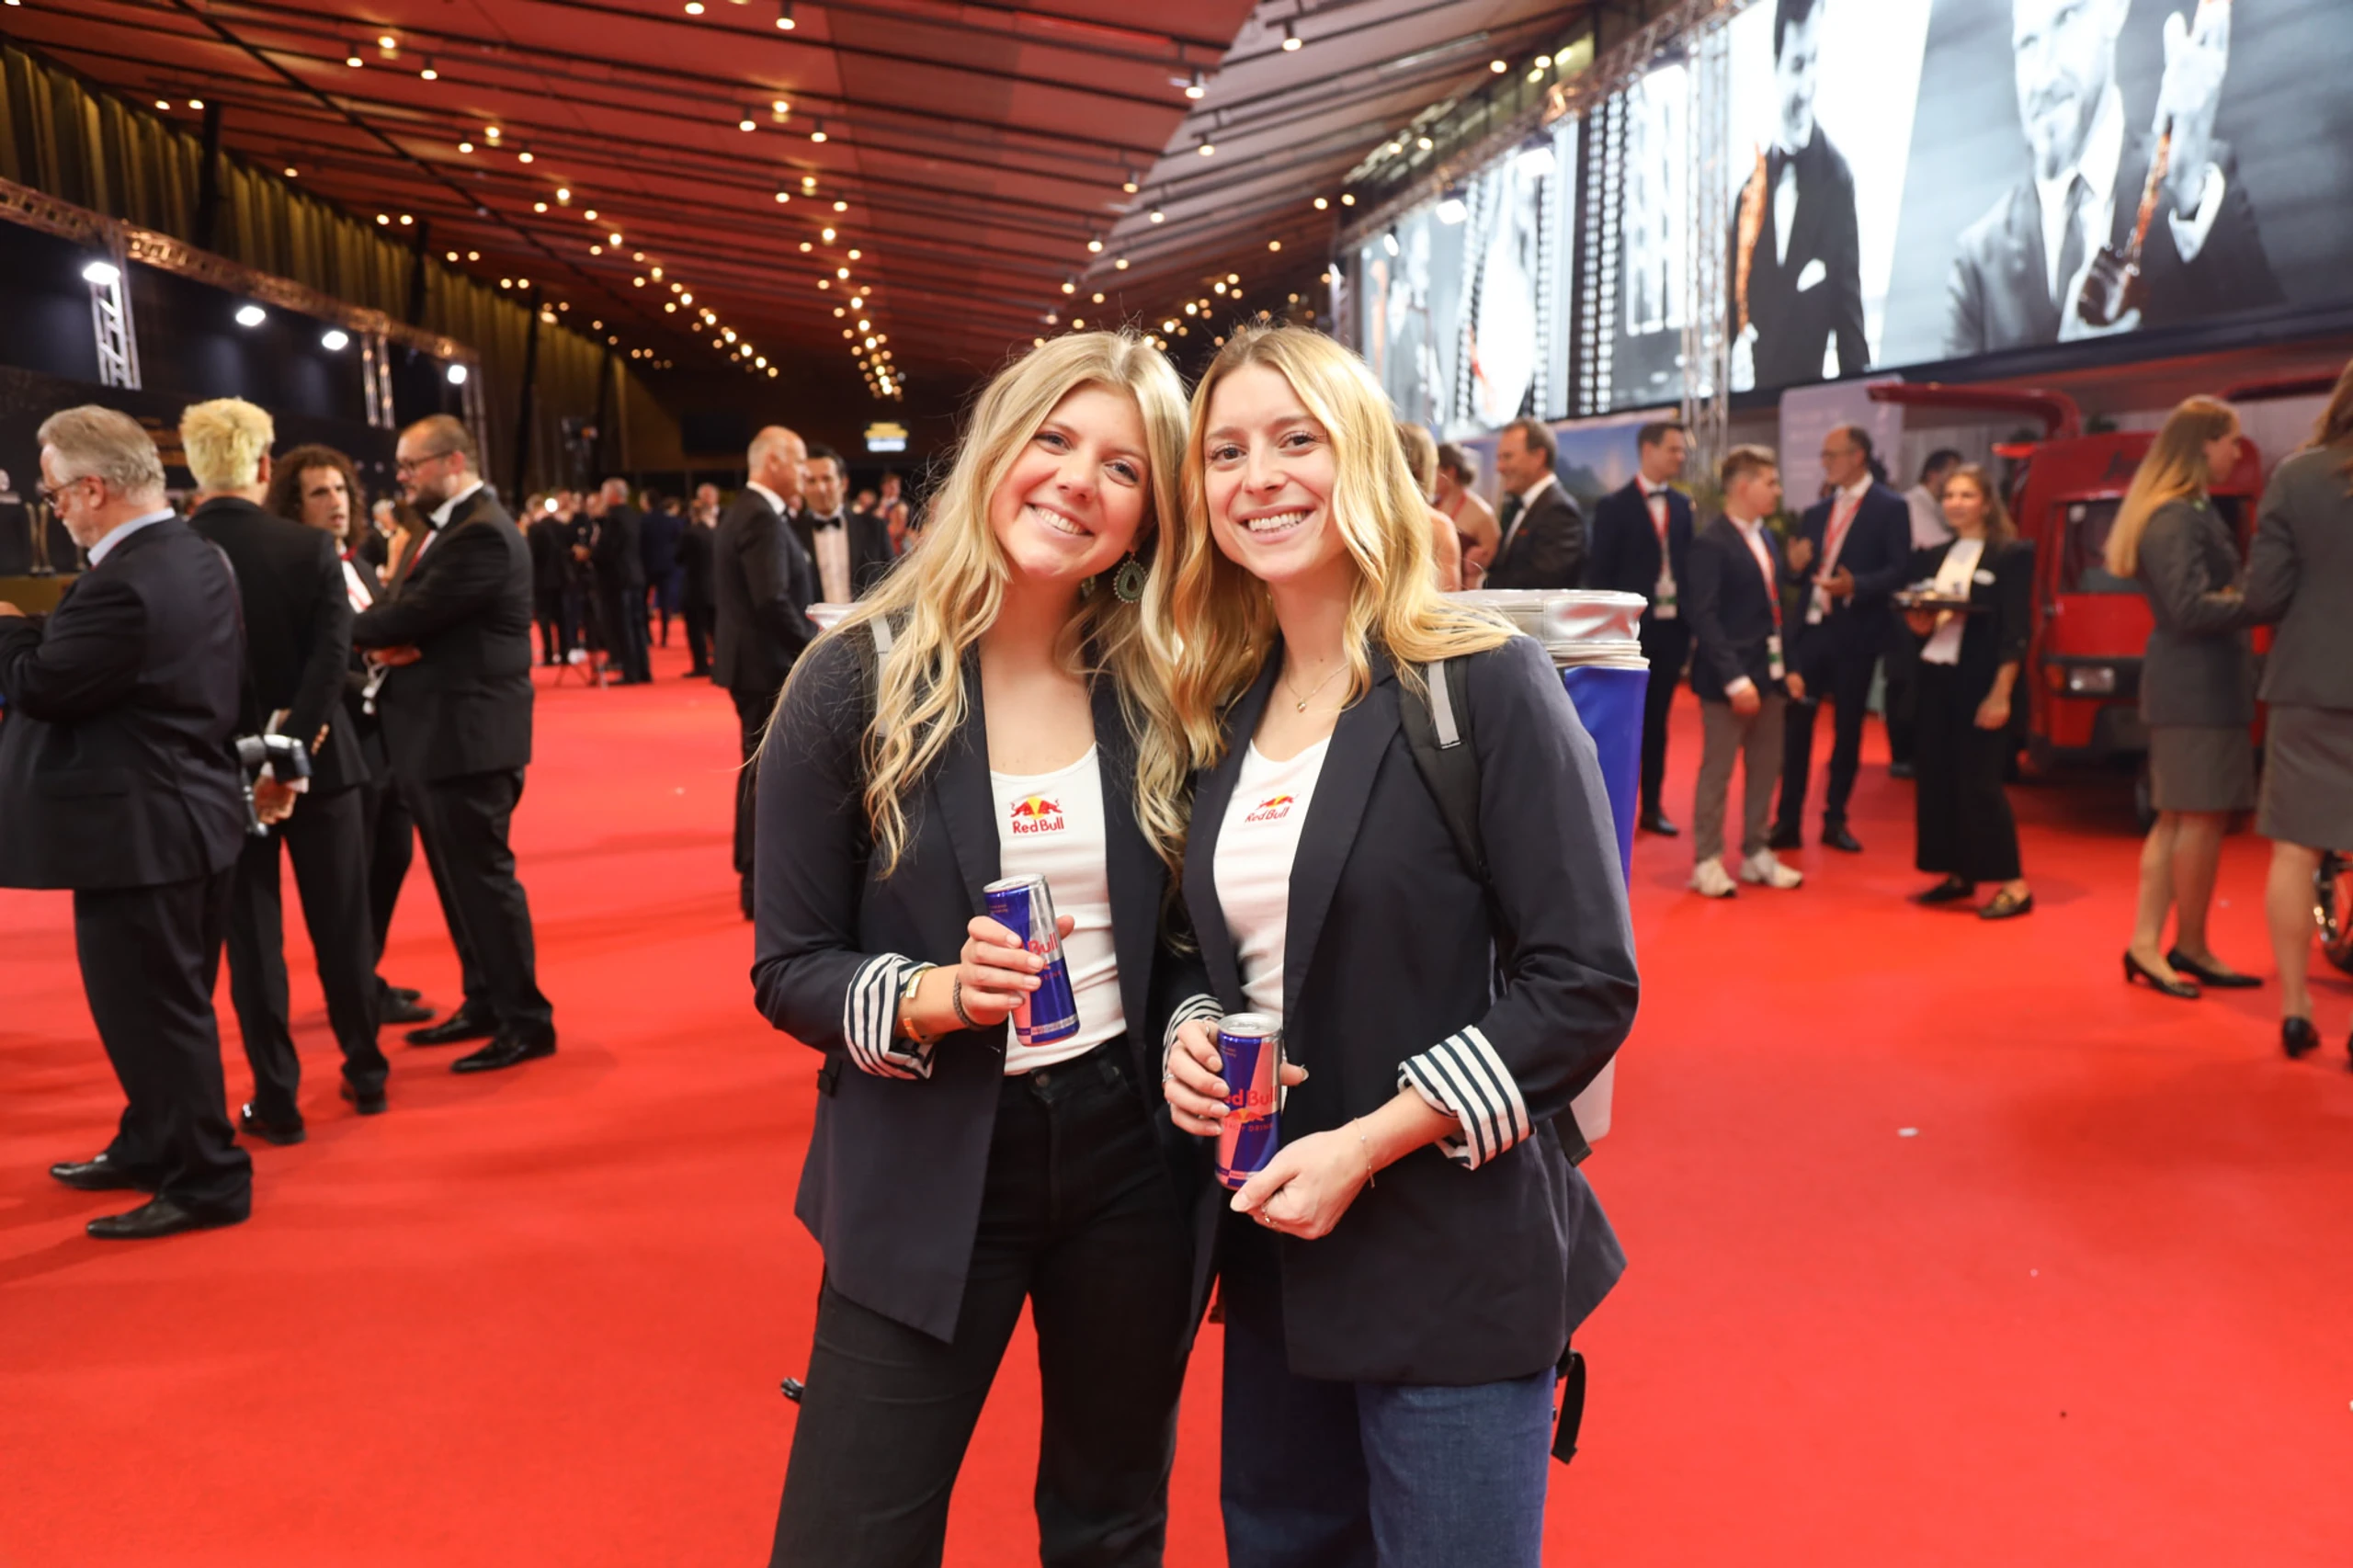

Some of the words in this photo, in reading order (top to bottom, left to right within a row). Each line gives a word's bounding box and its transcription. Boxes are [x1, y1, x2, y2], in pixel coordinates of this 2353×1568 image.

[1245, 809, 1267, 824] Red
[1266, 806, 1290, 820] Bull
[1012, 819, 1039, 835] Red
[1040, 816, 1064, 832] Bull
[1027, 932, 1059, 956] Bull
[1223, 1088, 1245, 1107] ed
[1245, 1085, 1278, 1107] Bull
